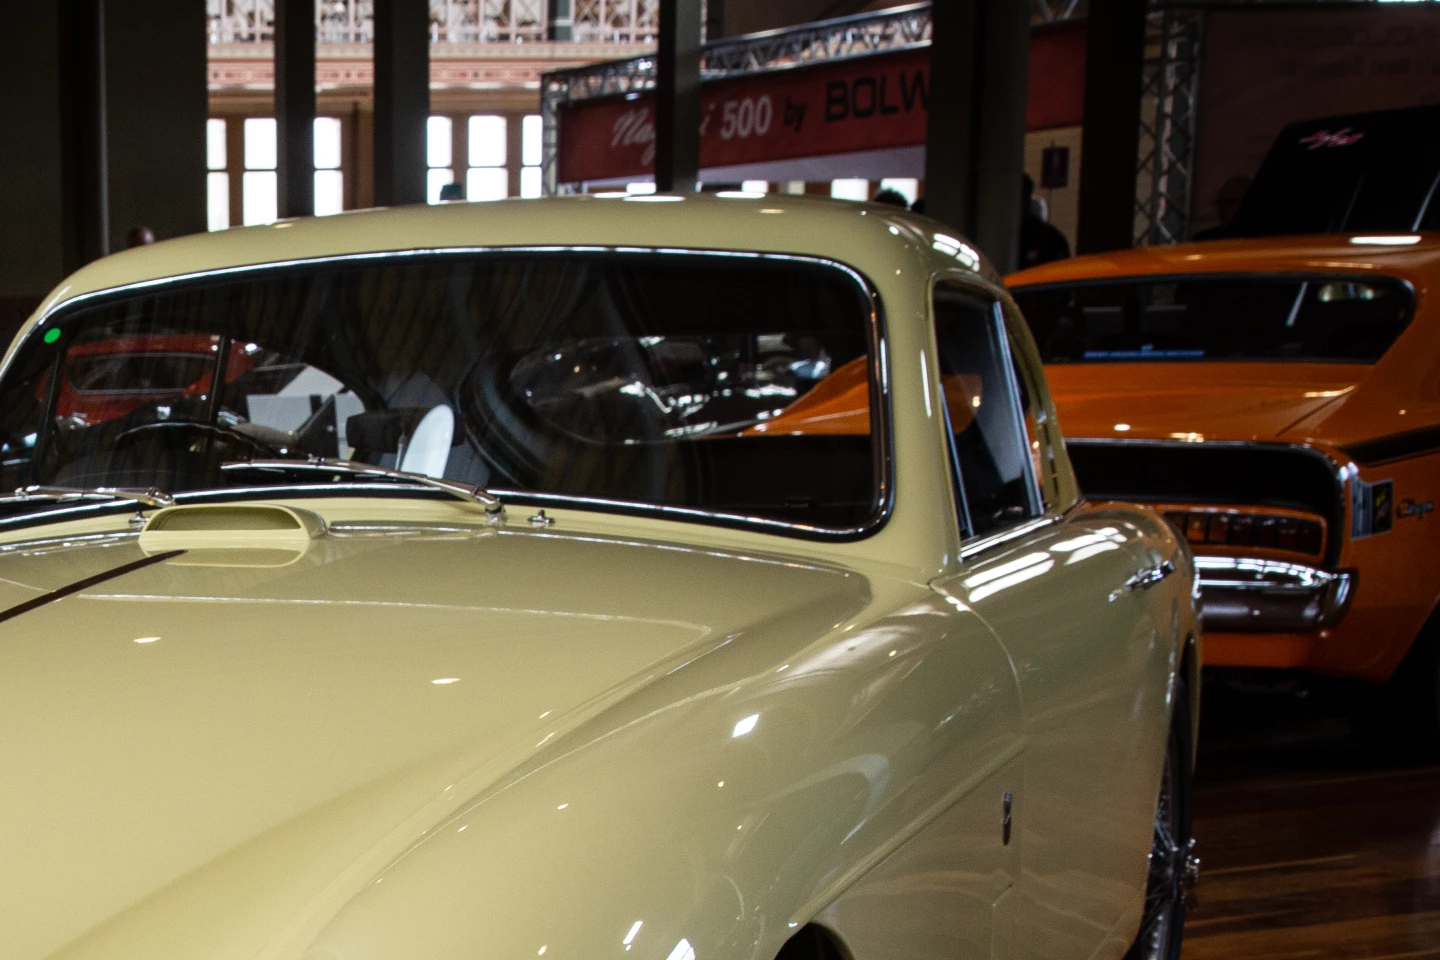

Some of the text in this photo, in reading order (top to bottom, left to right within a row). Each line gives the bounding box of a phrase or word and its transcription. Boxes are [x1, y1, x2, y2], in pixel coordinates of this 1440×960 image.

[611, 102, 717, 166] Nai
[720, 95, 773, 140] 500
[783, 98, 809, 132] by
